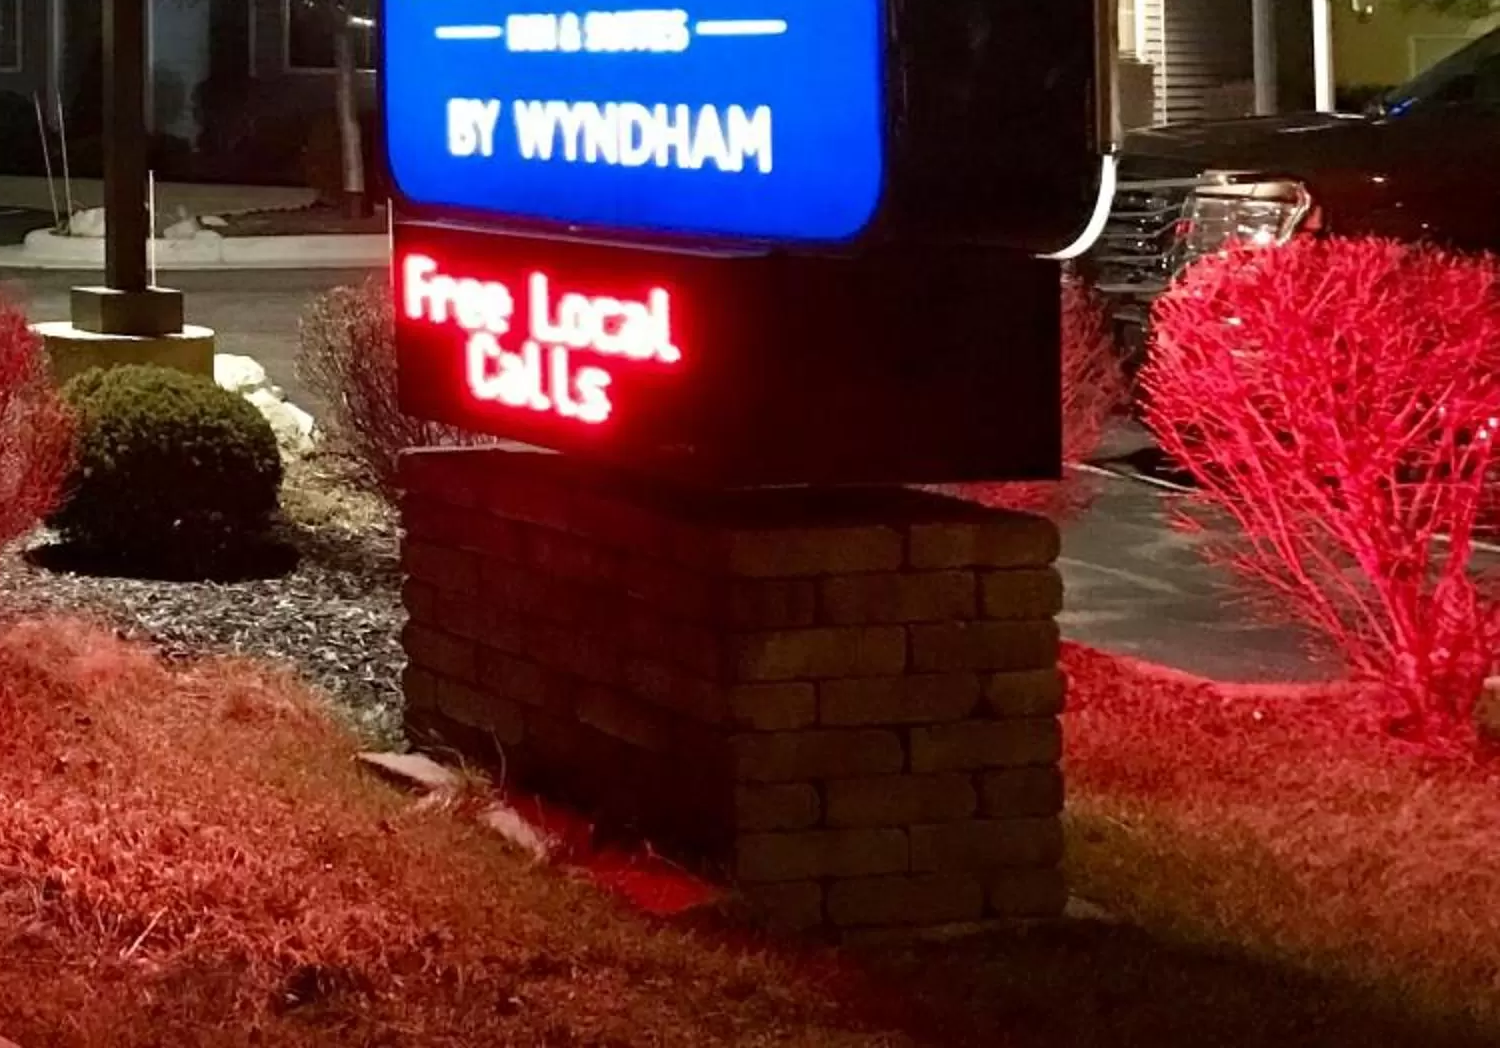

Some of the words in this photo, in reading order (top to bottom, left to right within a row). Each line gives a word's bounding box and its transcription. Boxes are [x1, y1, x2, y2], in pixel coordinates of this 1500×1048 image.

[447, 97, 500, 157] BY
[514, 99, 773, 174] WYNDHAM
[404, 254, 513, 335] Free
[530, 271, 681, 363] Local
[467, 332, 612, 424] Calls
